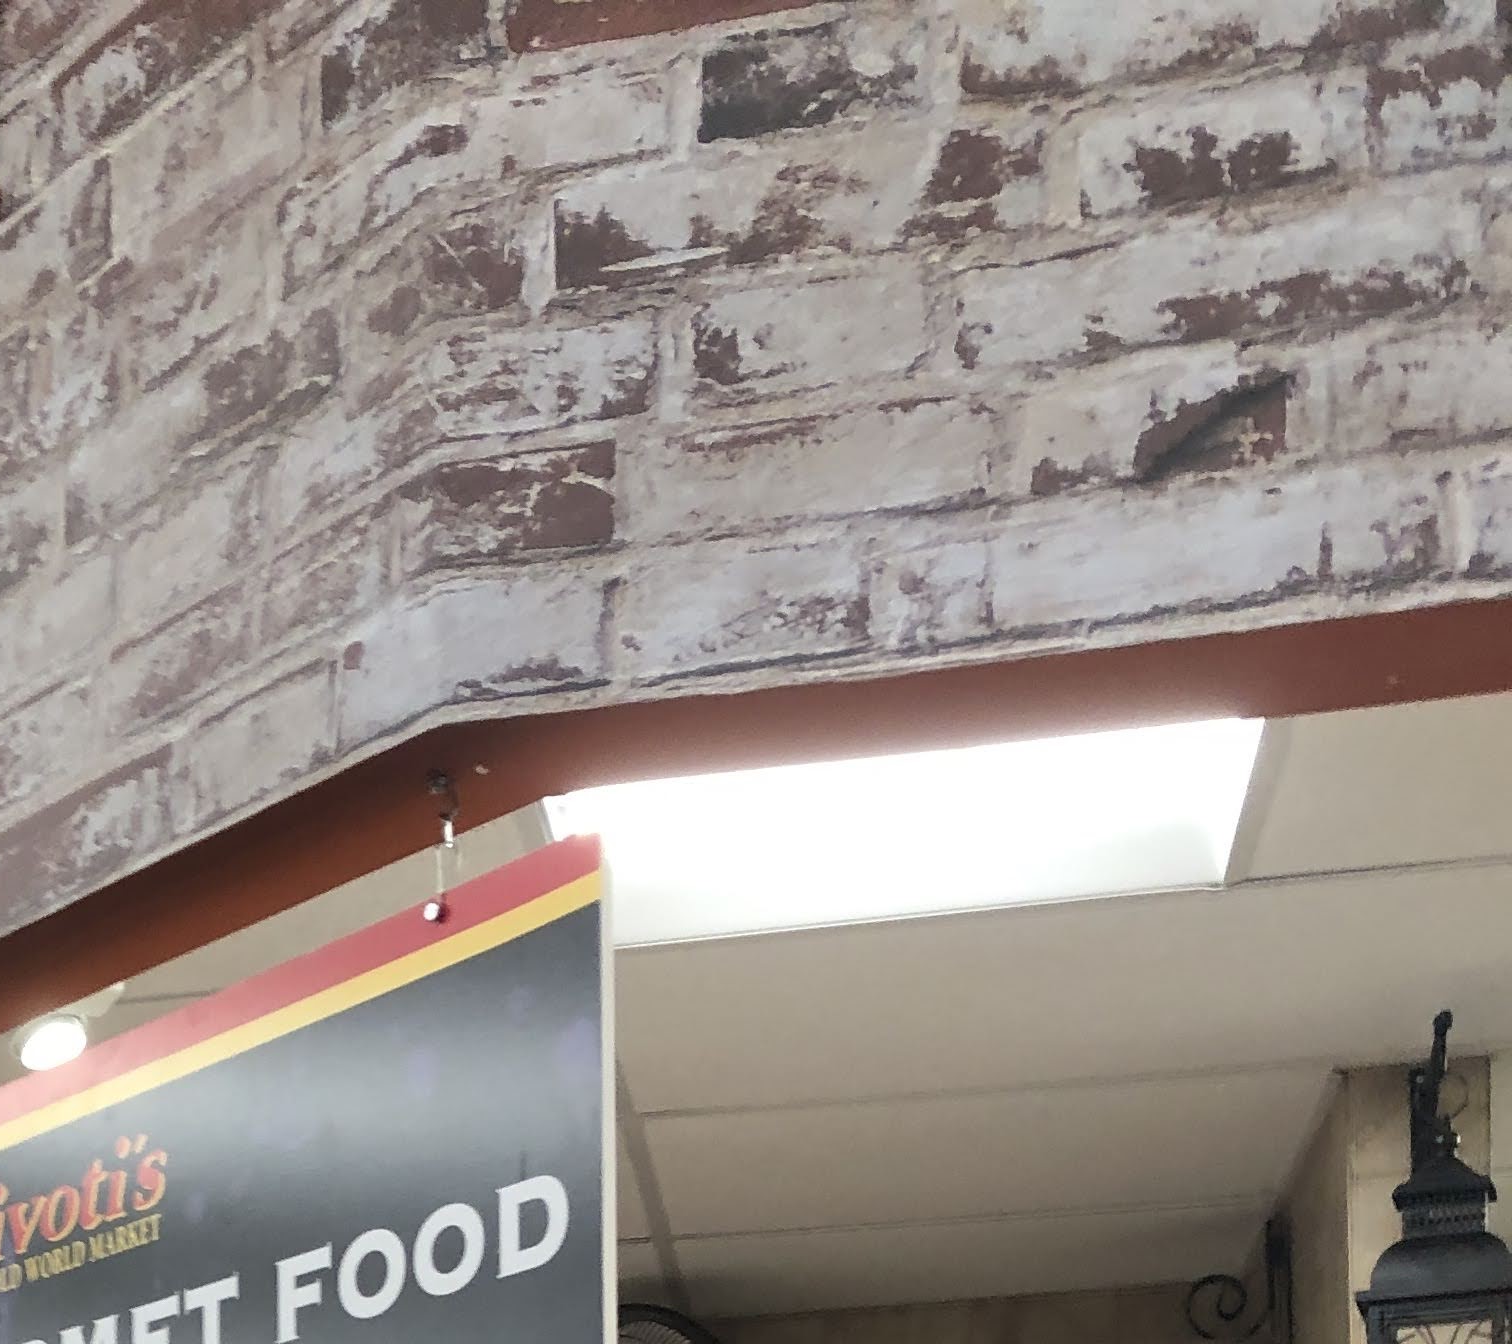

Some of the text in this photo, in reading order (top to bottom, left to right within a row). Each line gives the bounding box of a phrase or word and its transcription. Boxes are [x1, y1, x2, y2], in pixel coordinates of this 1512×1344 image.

[24, 1240, 86, 1282] WORLD
[88, 1213, 163, 1263] MARKET
[274, 1174, 570, 1344] FOOD
